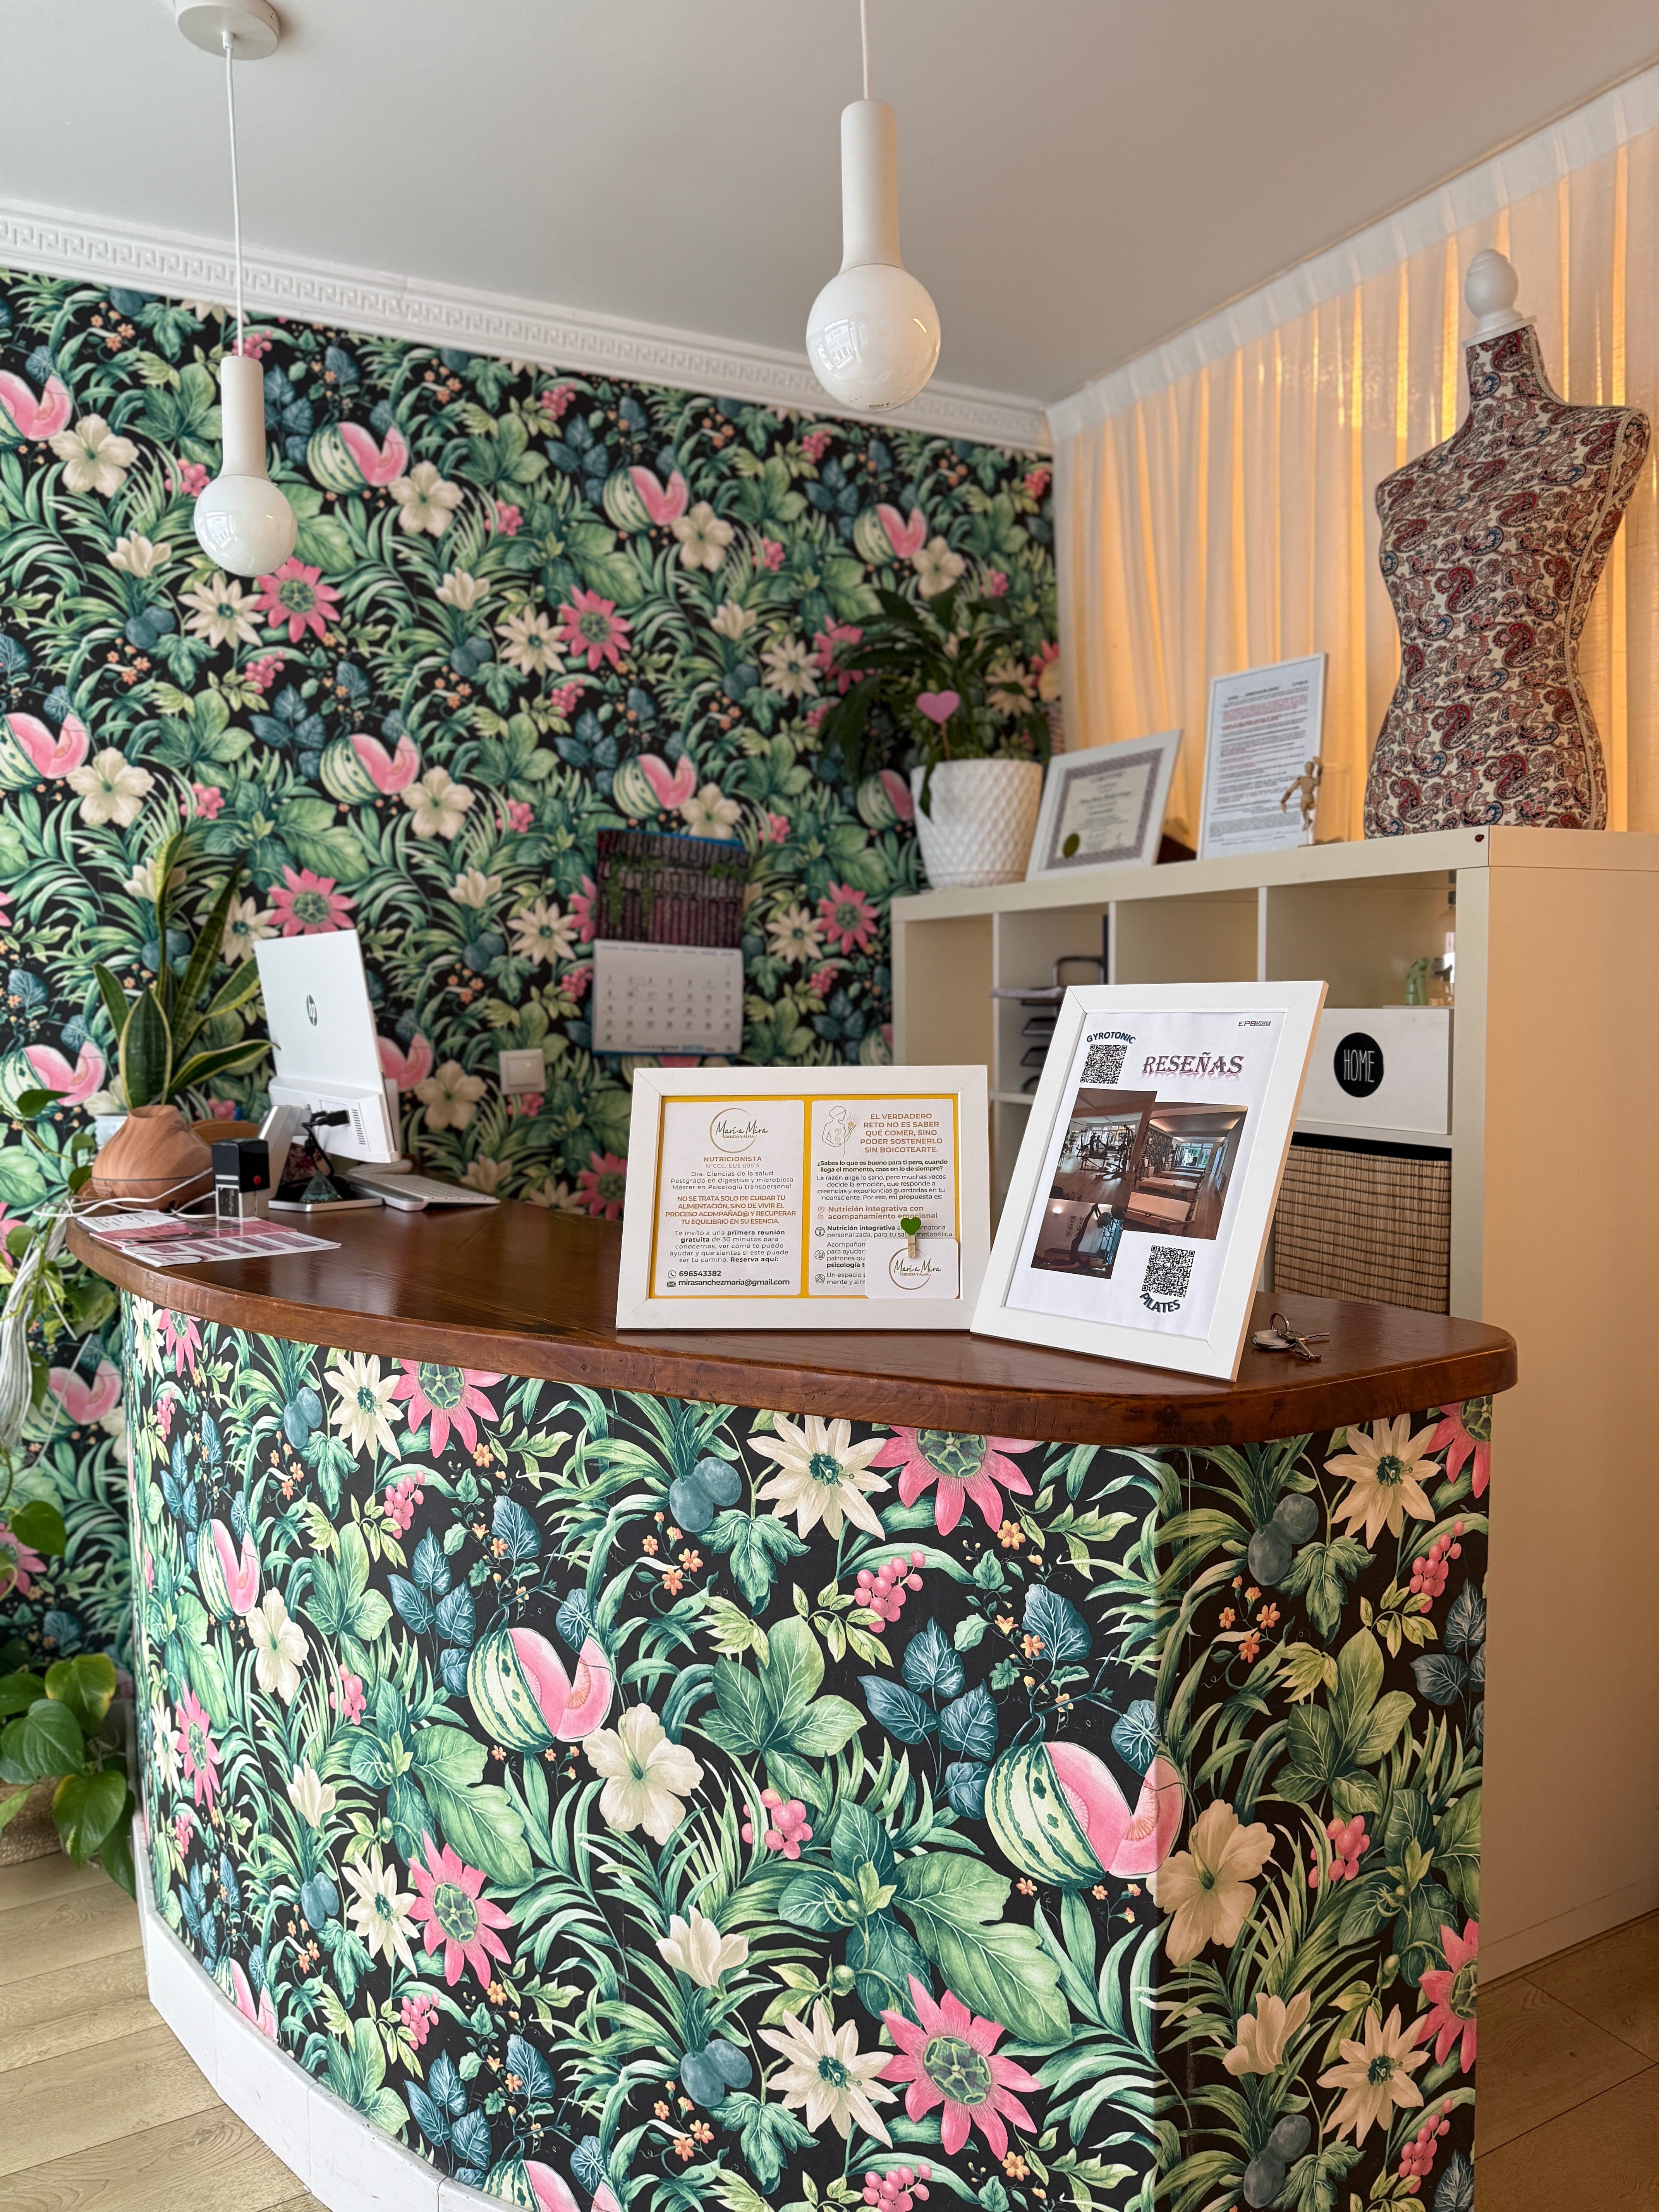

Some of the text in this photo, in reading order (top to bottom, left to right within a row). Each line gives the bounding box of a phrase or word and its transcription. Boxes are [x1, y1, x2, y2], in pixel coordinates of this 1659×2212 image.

[1086, 1031, 1136, 1044] GYROTONIC
[1142, 1052, 1245, 1074] RESEÑAS
[1343, 1049, 1375, 1082] HOME
[716, 1119, 768, 1138] María Mira
[894, 1259, 942, 1275] María Mira
[1139, 1292, 1181, 1313] PILATES
